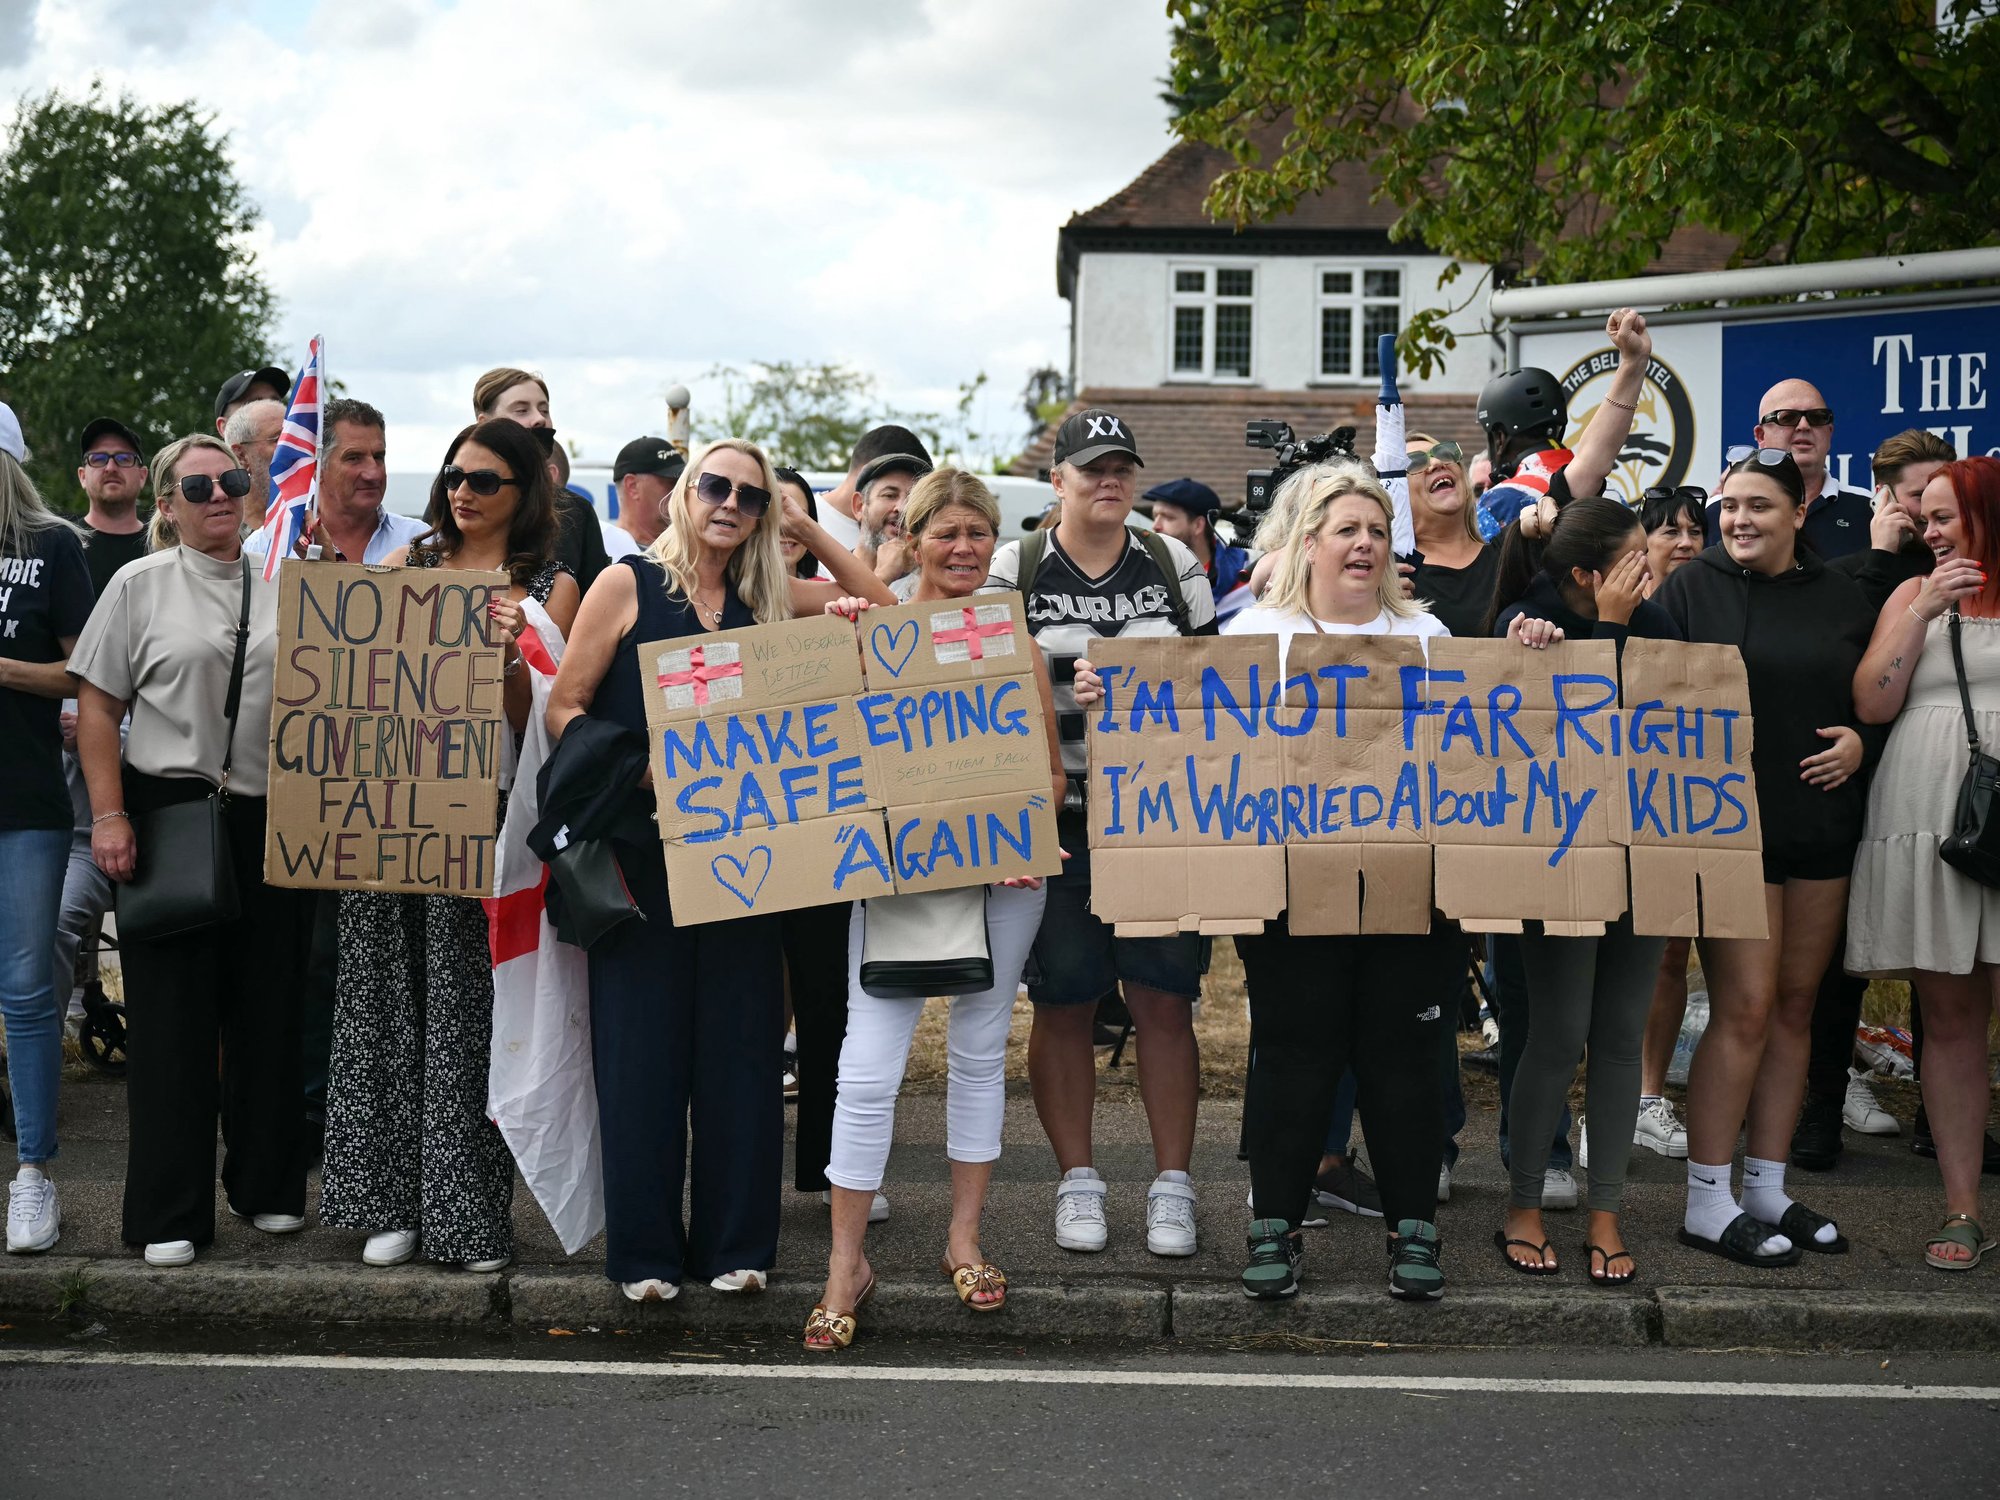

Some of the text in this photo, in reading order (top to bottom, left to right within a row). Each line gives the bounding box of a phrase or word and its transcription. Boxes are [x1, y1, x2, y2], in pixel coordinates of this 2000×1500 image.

[1562, 364, 1590, 393] THE
[1590, 353, 1619, 374] BEL
[1873, 333, 1987, 414] THE
[1086, 415, 1127, 439] XX
[1253, 486, 1264, 496] 99
[297, 577, 511, 648] NO MORE
[1028, 584, 1173, 622] COURAGE
[761, 656, 833, 688] BETTER
[664, 702, 839, 779] MAKE
[857, 681, 1030, 753] EPPING
[1096, 665, 1180, 733] I'M
[1201, 664, 1369, 740] NOT
[1399, 665, 1535, 758] FAR
[1552, 673, 1740, 764] RIGHT
[275, 710, 502, 779] GOVERNMENT
[896, 752, 1032, 782] SEND THEM BACK
[319, 777, 434, 829] FAIL
[676, 755, 867, 844] SAFE
[1102, 760, 1179, 835] I'M
[1186, 752, 1384, 846] WORRIED
[1627, 767, 1749, 838] KIDS
[276, 831, 494, 891] WE FIGHT
